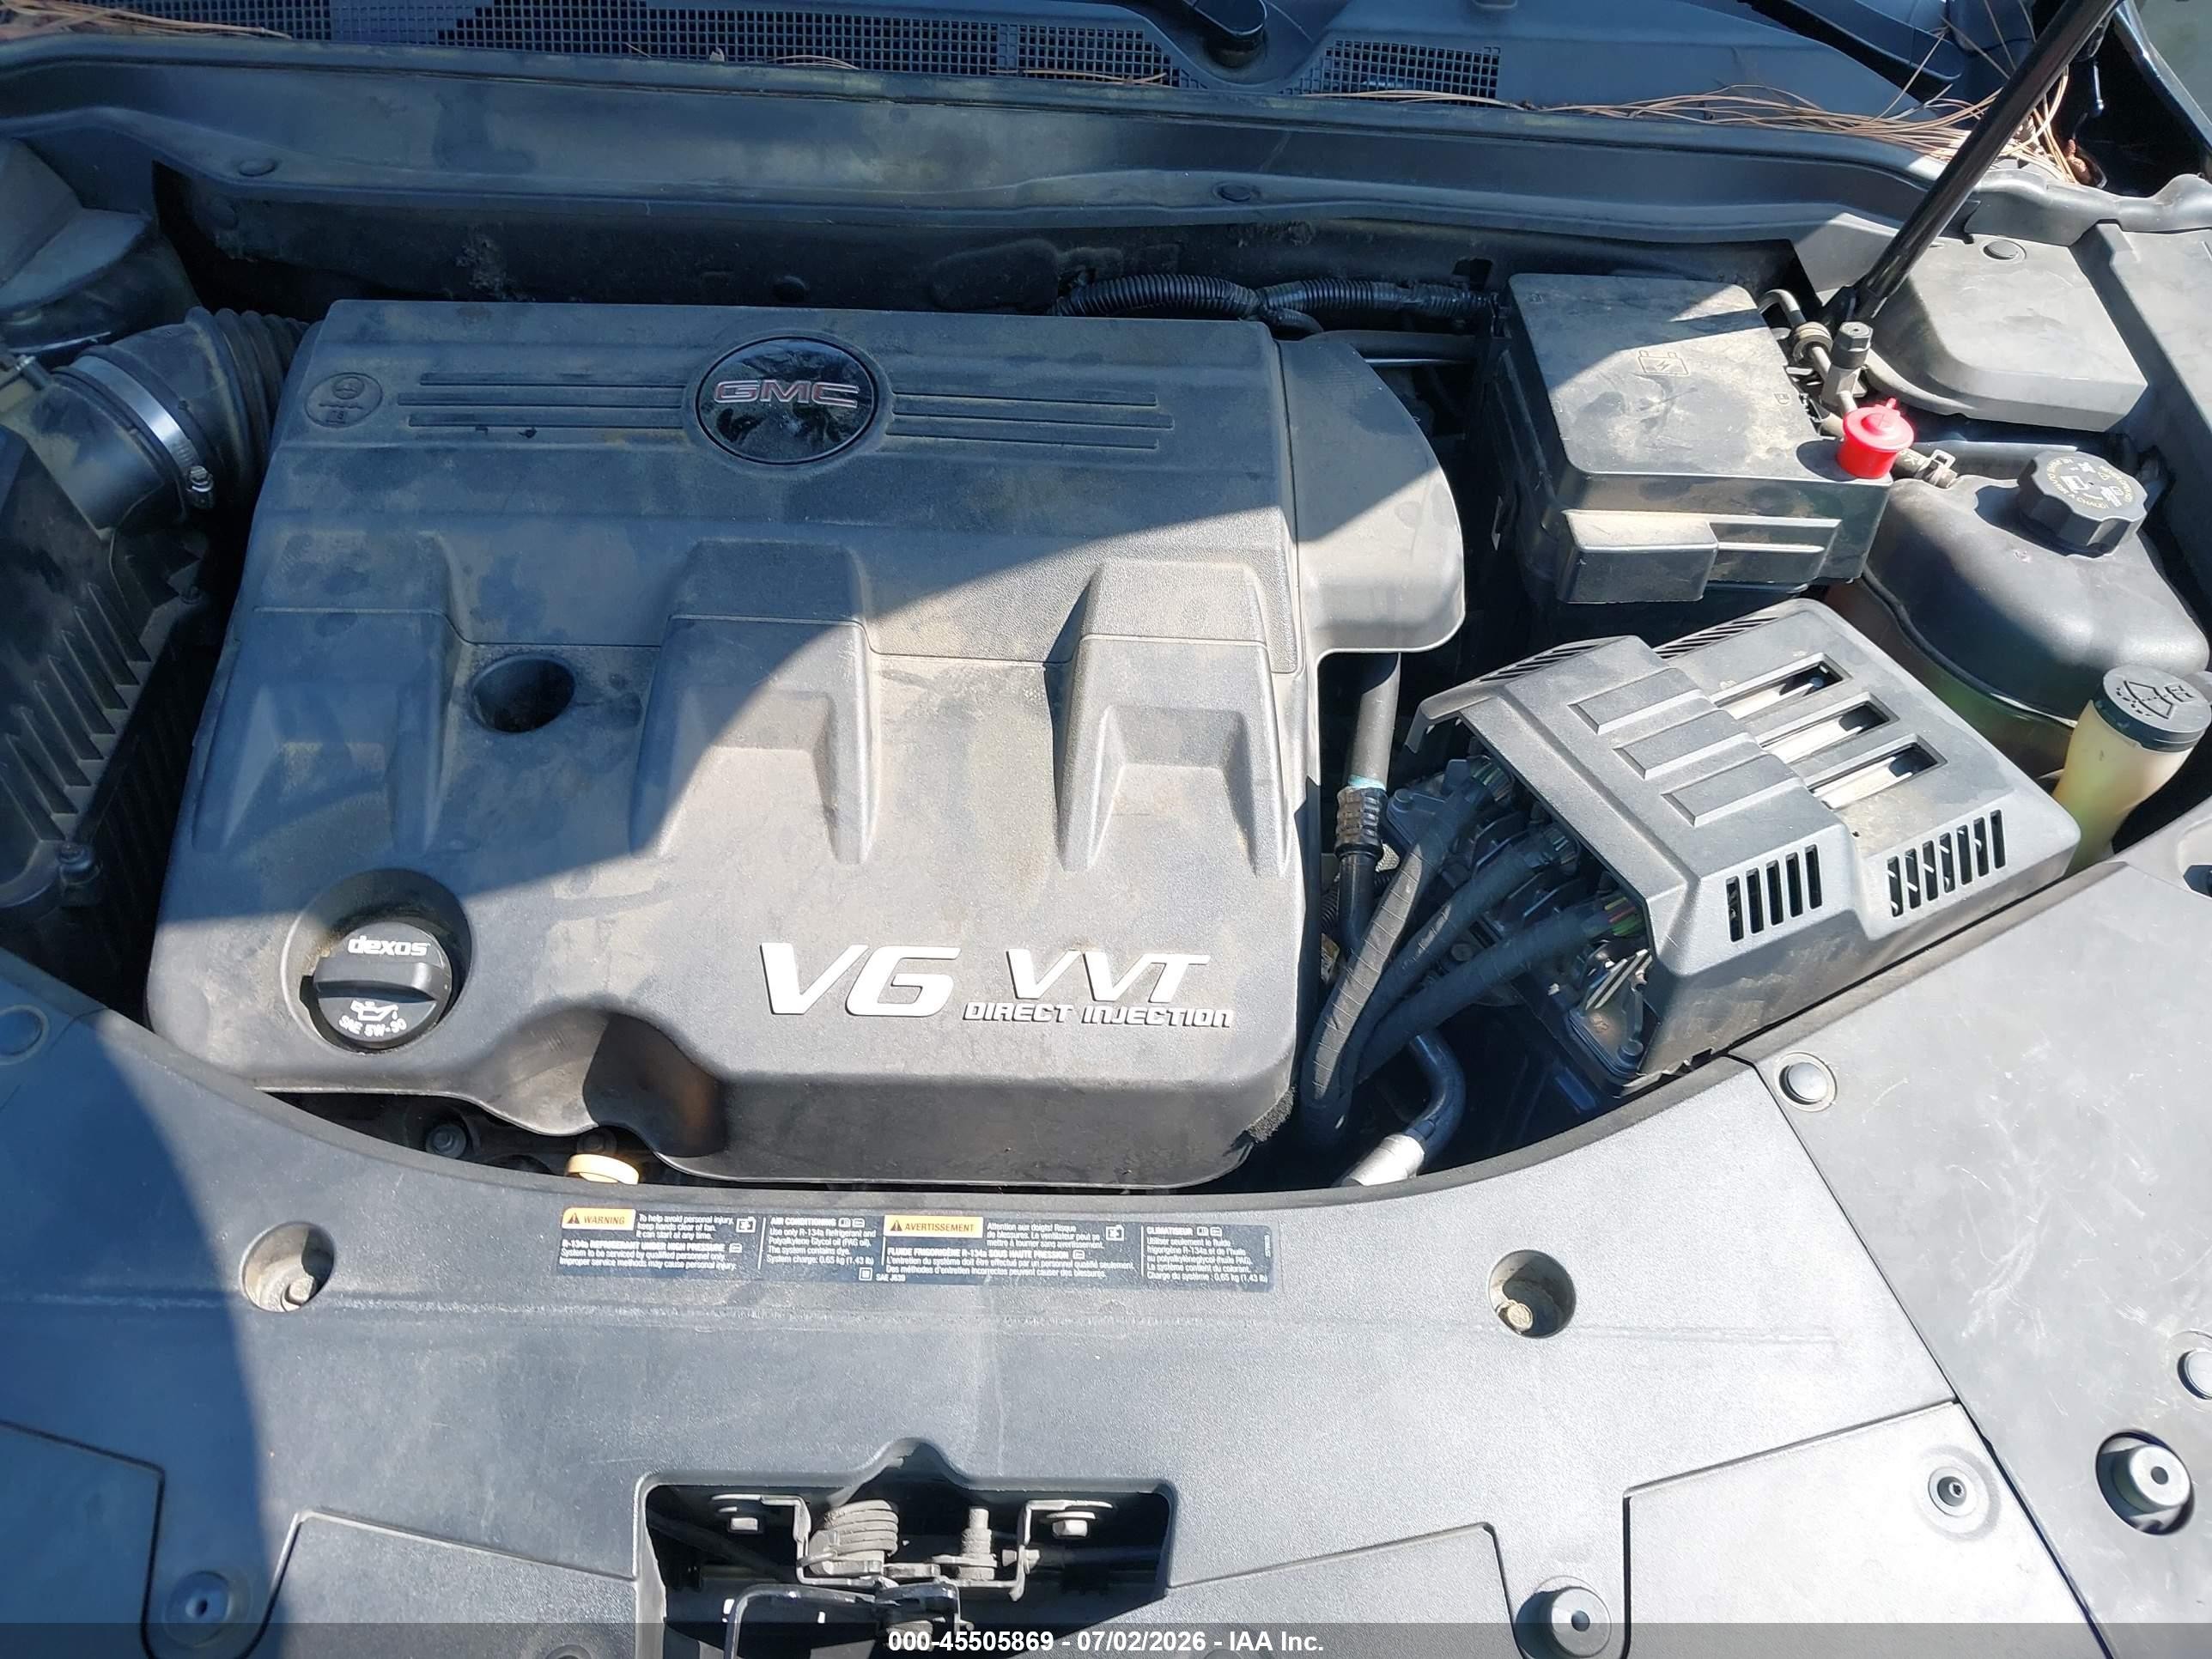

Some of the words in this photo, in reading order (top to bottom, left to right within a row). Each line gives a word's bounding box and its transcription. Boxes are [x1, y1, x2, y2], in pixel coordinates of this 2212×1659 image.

[714, 380, 859, 409] GMC
[348, 936, 428, 956] dexos
[760, 943, 961, 1017] V6
[1006, 949, 1211, 1002] VVT
[963, 1002, 1073, 1024] DIRECT
[1082, 1005, 1233, 1028] INJECTION
[339, 1015, 362, 1034] SAE
[364, 1018, 407, 1036] 5W-30
[584, 1216, 625, 1224] WARNING
[648, 1214, 663, 1224] help
[684, 1216, 712, 1224] personal
[637, 1223, 653, 1231] keep
[905, 1223, 974, 1231] AVERTISSEMENT
[826, 1230, 862, 1238] Refrigerant
[561, 1249, 586, 1257] System
[646, 1251, 675, 1260] qualified
[677, 1252, 709, 1261] personnel
[837, 1248, 850, 1256] dye.
[560, 1257, 590, 1267] Improper
[685, 1261, 714, 1270] personal
[1231, 1274, 1239, 1283] kg
